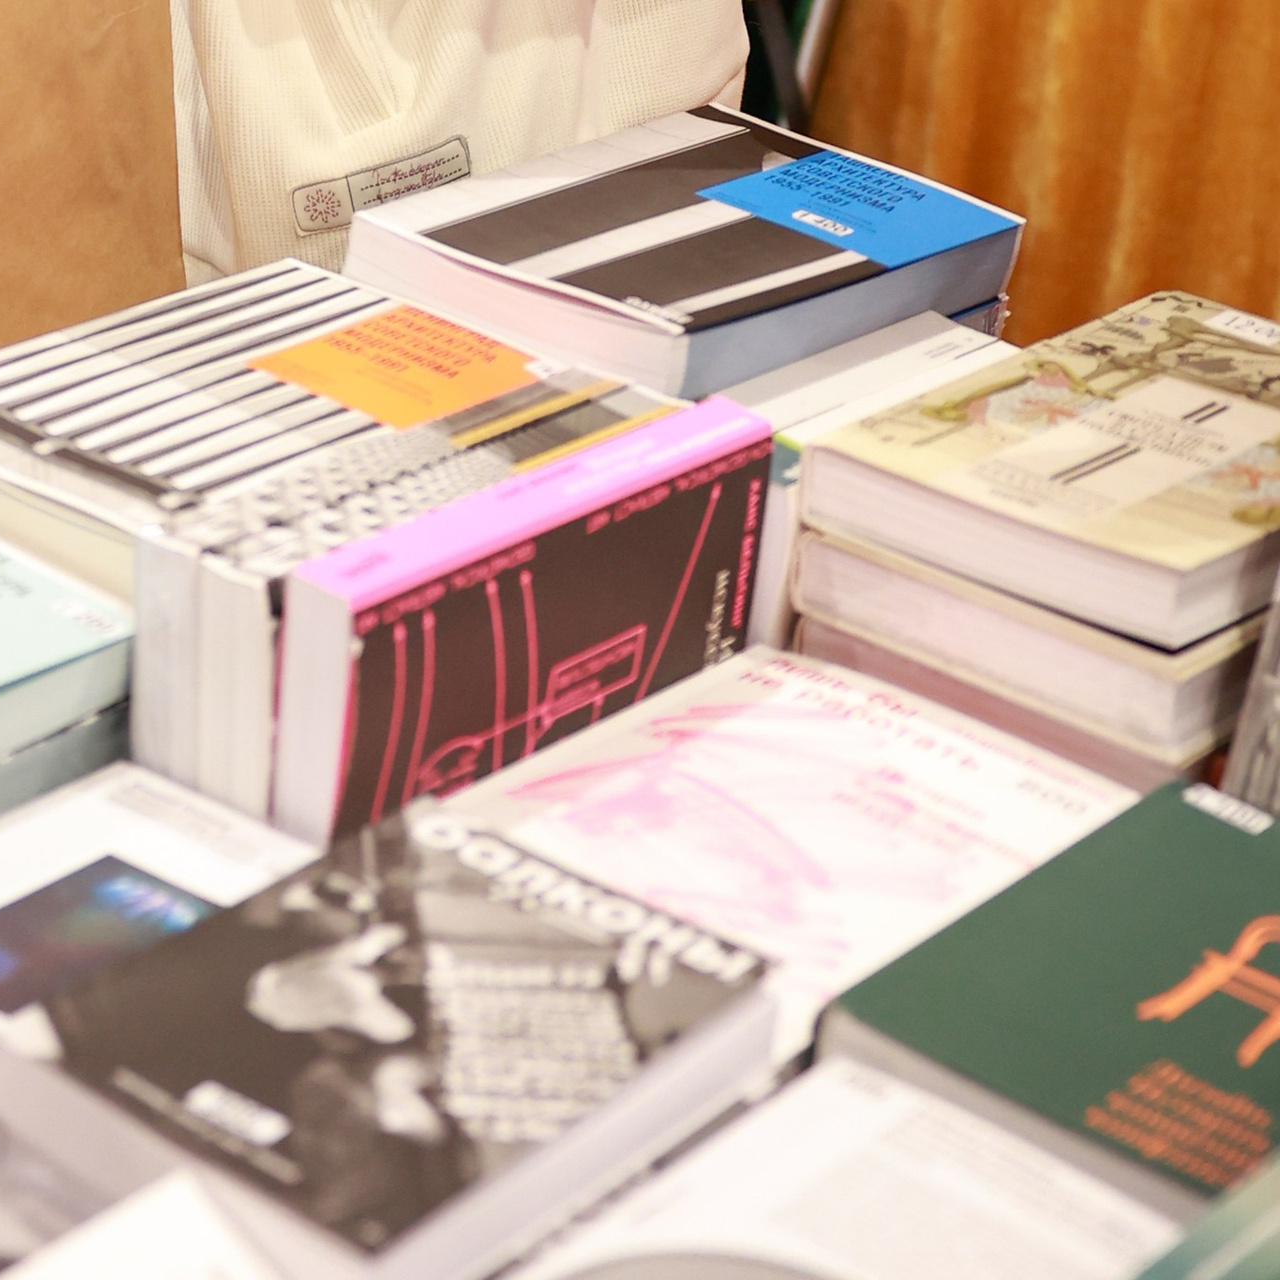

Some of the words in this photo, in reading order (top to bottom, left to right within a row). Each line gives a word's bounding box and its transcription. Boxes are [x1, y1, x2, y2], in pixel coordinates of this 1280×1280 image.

[781, 168, 896, 214] МОДЕРНИЗМА
[796, 163, 903, 203] СОВЕТСКОГО
[814, 158, 927, 201] АРХИТЕКТУРА
